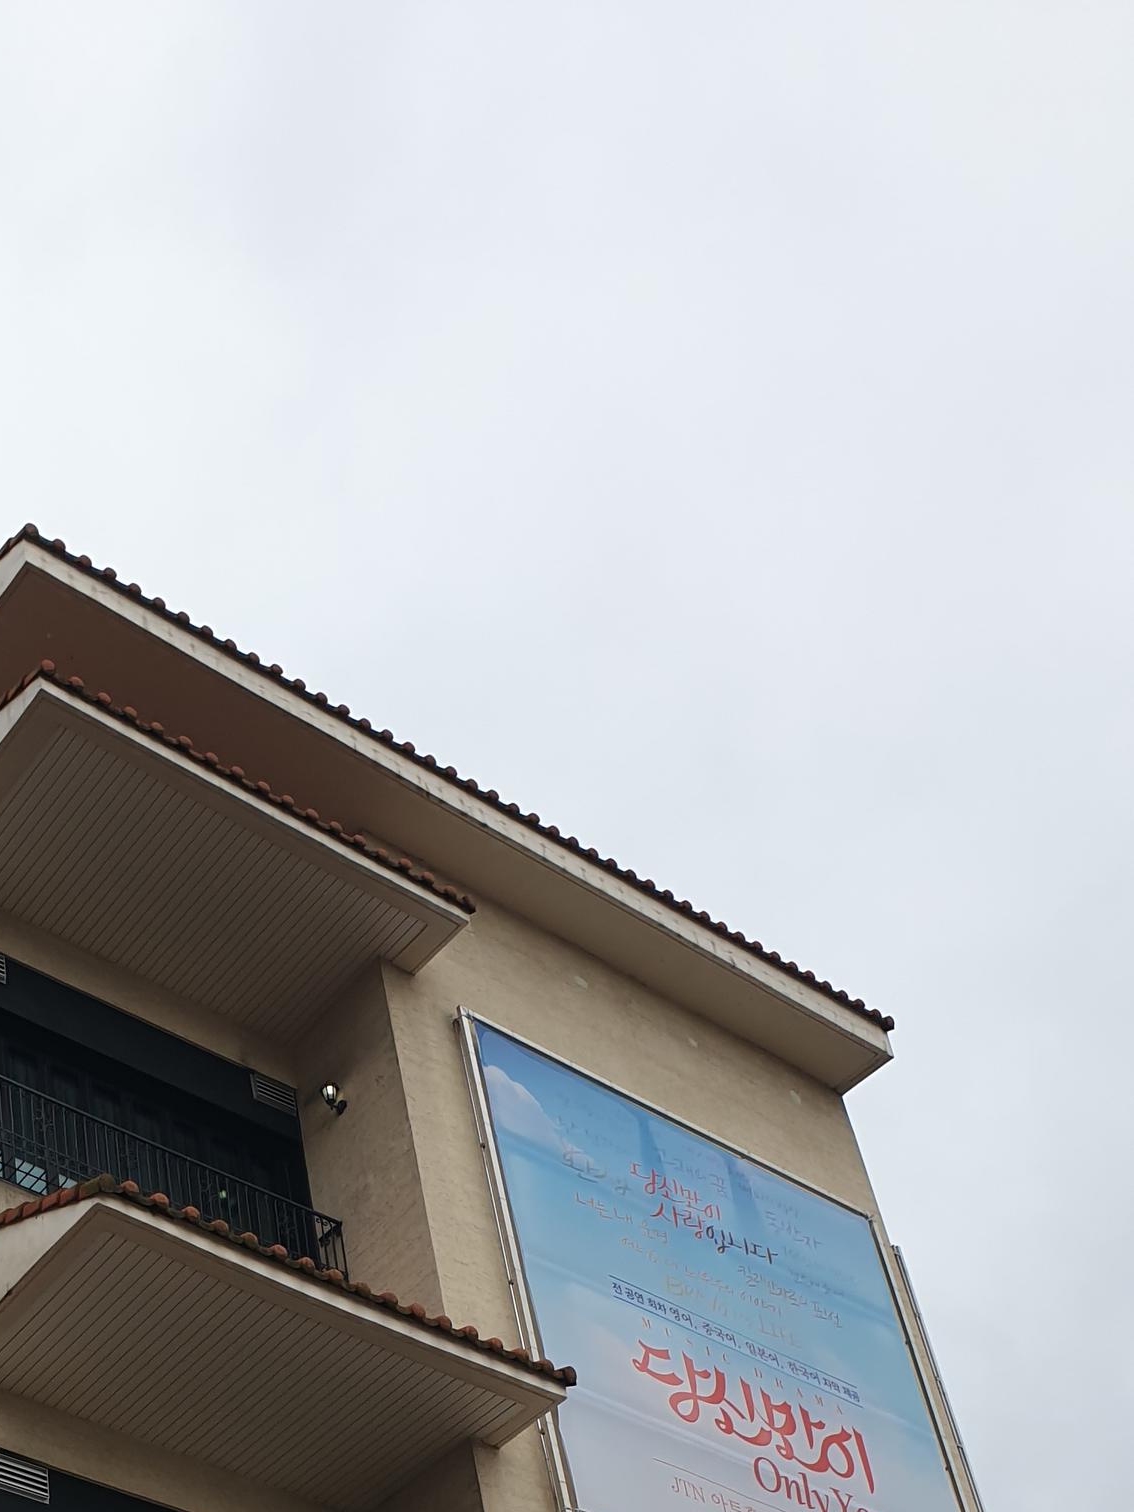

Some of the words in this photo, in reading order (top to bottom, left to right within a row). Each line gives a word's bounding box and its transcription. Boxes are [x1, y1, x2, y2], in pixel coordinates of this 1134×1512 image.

[629, 1161, 722, 1222] 당신만이
[649, 1202, 779, 1264] 사랑입니다
[625, 1286, 644, 1304] 공연
[633, 1338, 875, 1494] 당신만이
[671, 1476, 707, 1504] JTN
